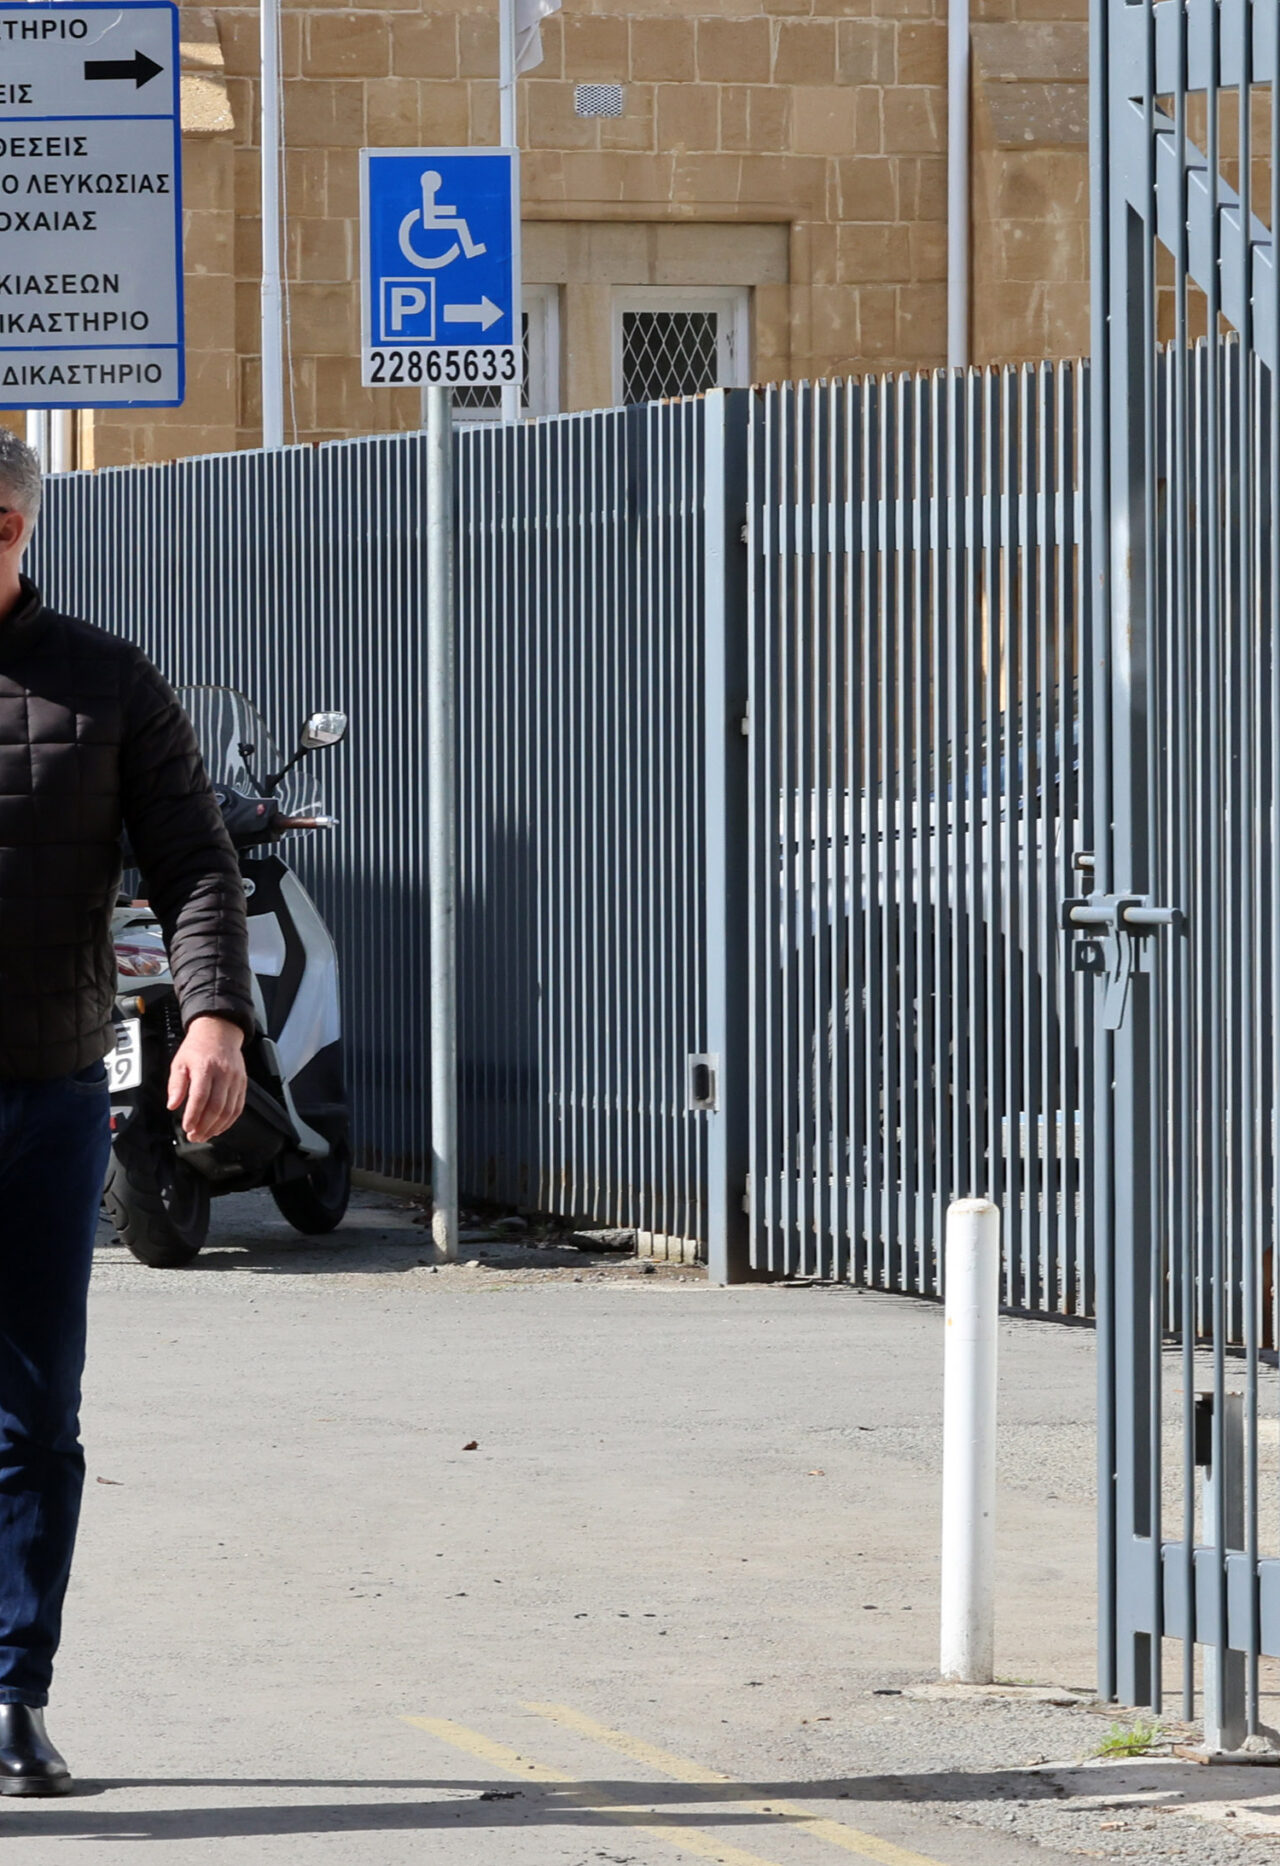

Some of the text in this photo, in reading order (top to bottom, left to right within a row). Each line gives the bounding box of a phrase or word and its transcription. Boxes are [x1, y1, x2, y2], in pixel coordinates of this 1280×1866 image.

[26, 174, 170, 194] ΛΕΥΚΩΣΙΑΣ
[391, 287, 426, 331] P
[1, 364, 162, 386] ΔΙΚΑΣΤΗΡΙΟ
[370, 349, 516, 383] 22865633
